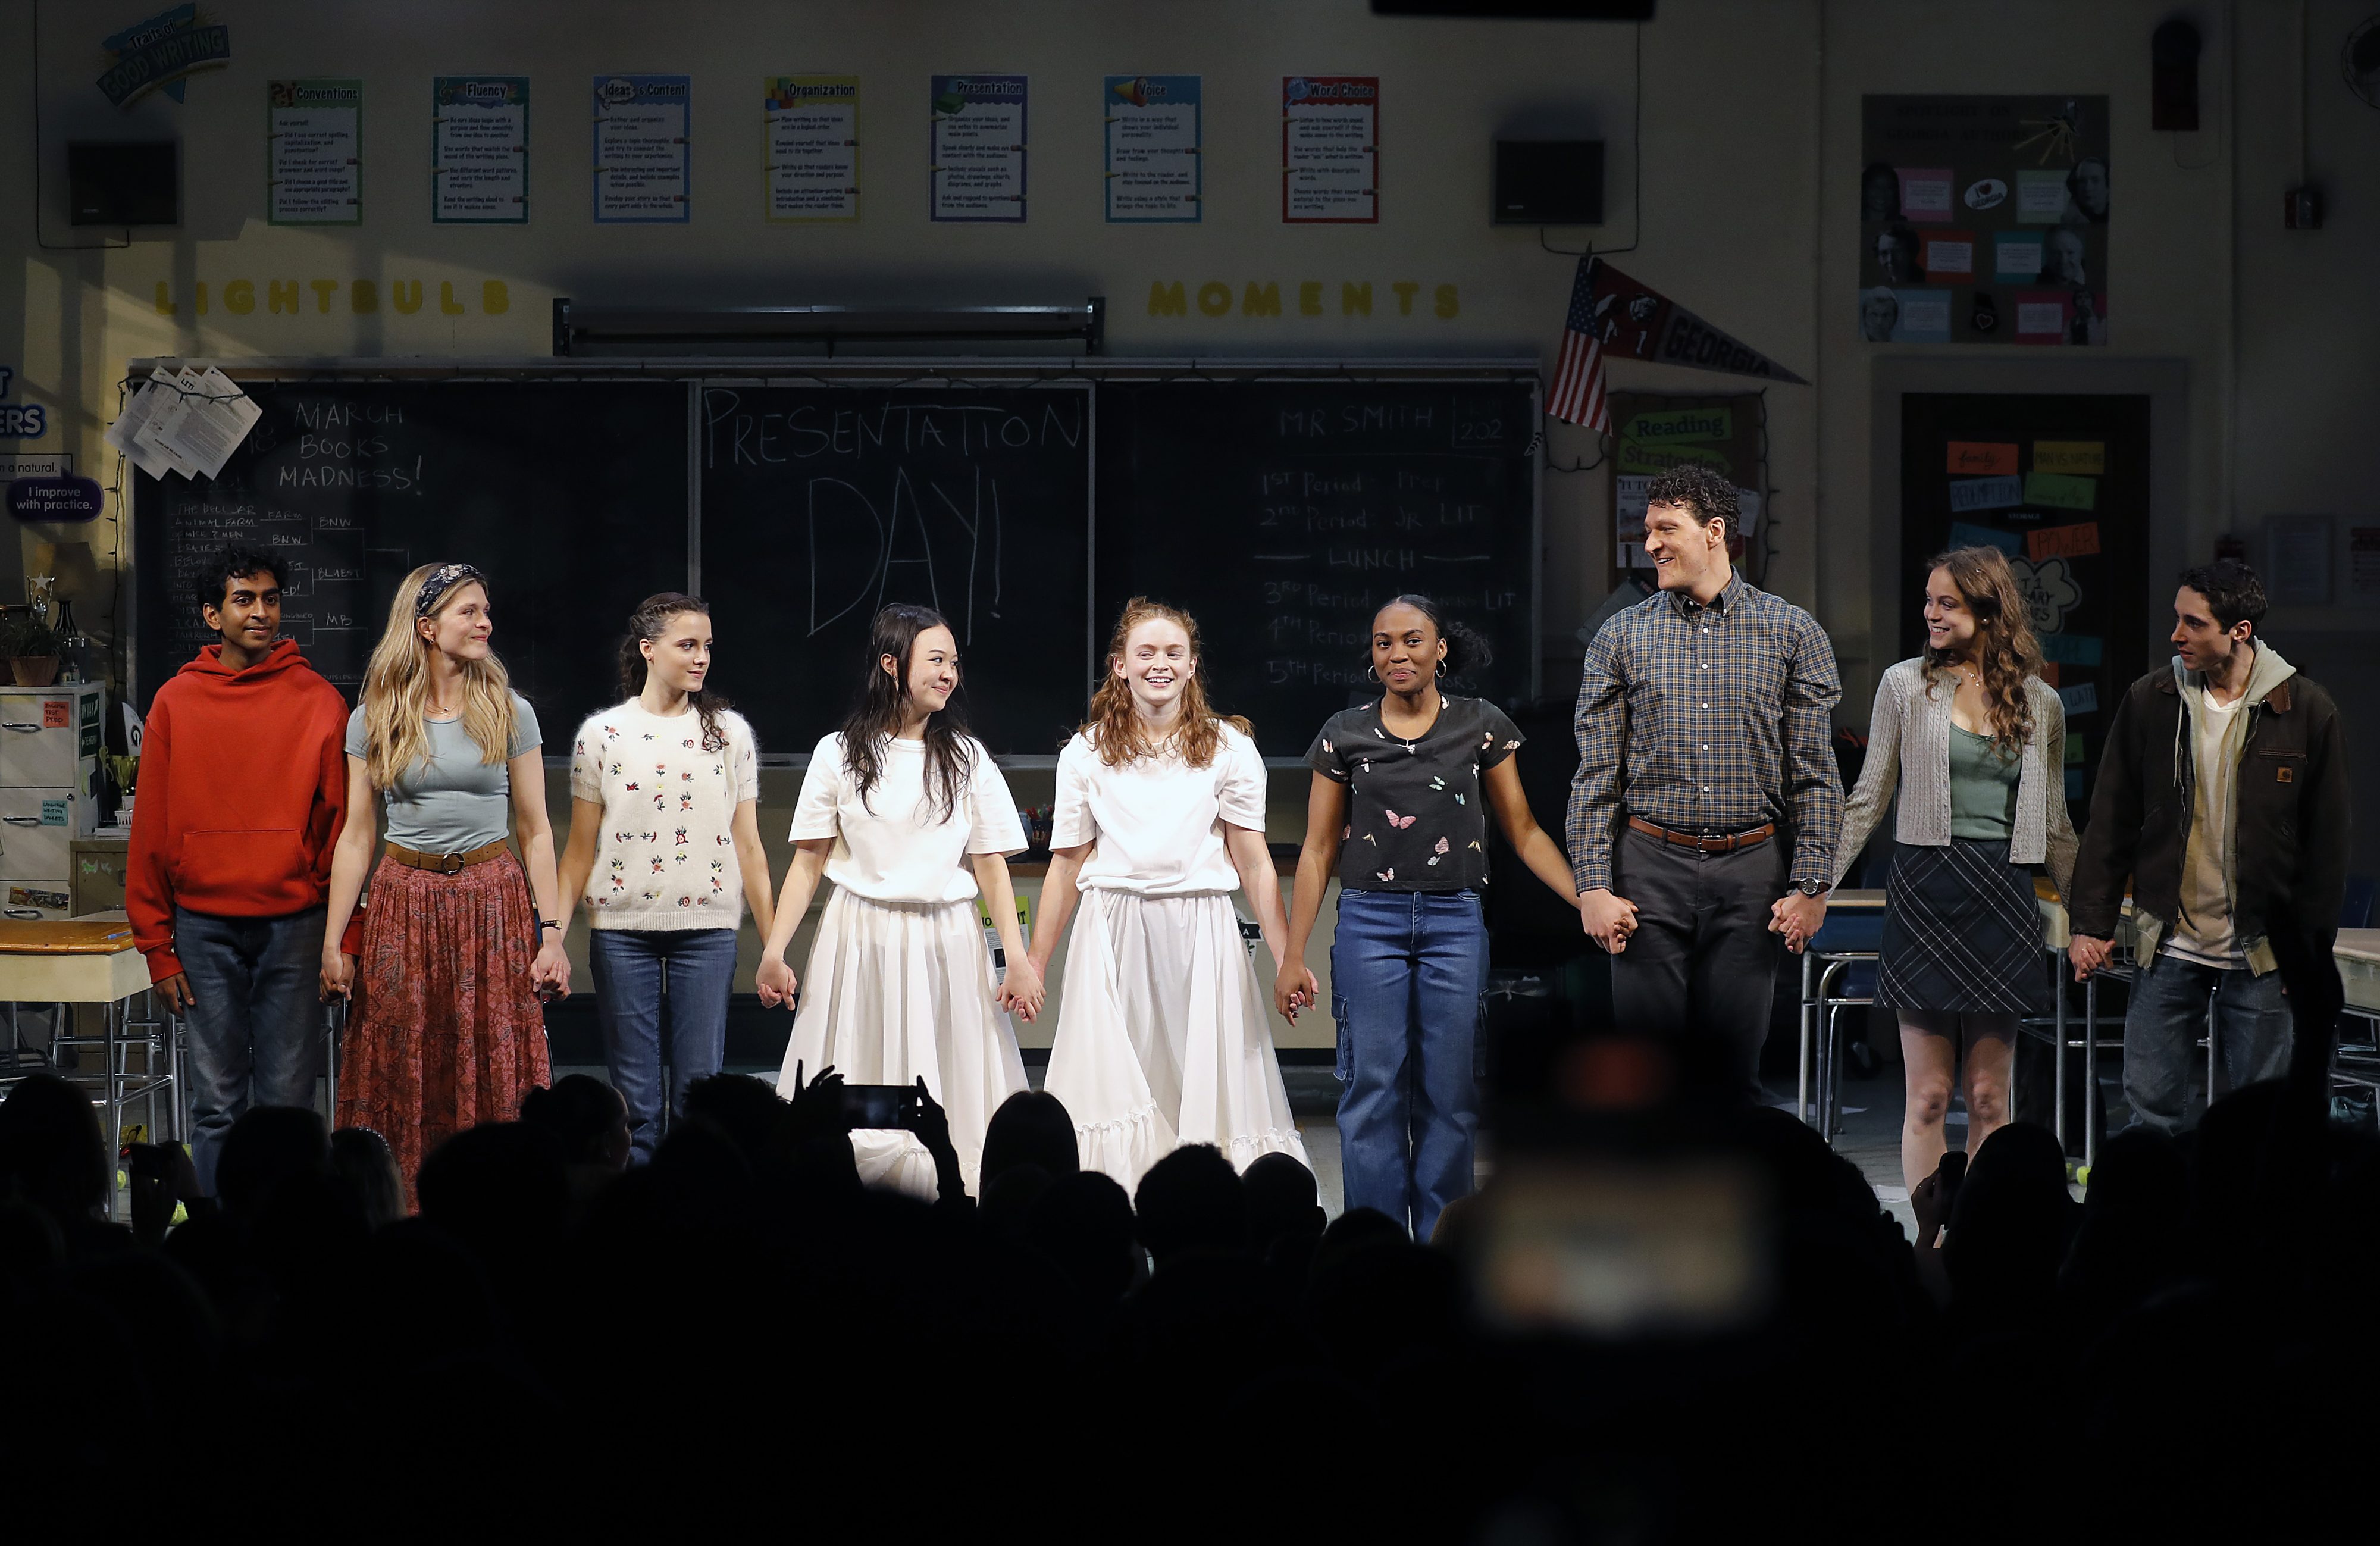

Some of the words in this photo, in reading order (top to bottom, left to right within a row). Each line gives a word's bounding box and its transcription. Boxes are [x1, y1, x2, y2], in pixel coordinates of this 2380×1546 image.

[129, 27, 162, 50] Traits
[162, 18, 177, 36] of
[104, 56, 150, 94] GOOD
[151, 29, 225, 69] WRITING
[298, 87, 358, 101] Conventions
[466, 82, 508, 99] Fluency
[605, 83, 631, 96] Ideas
[647, 83, 685, 96] Content
[789, 83, 856, 97] Organization
[957, 81, 1022, 95] Presentation
[1139, 83, 1167, 96] Voice
[1311, 83, 1338, 97] Word
[1342, 83, 1374, 97] Choice
[1990, 105, 2011, 117] ON
[1887, 128, 1949, 141] GEORGIA
[1959, 127, 2029, 141] AUTHORS
[155, 279, 510, 316] LIGHTBULB
[1147, 280, 1460, 319] MOMENTS
[1665, 315, 1770, 376] GEORGIA
[294, 401, 403, 430] MARCH
[1342, 404, 1433, 433] SMITH
[703, 388, 1082, 470] PRESENTATION
[1461, 418, 1504, 440] 202
[1636, 415, 1725, 437] Reading
[299, 433, 389, 460] BOOKS
[18, 462, 57, 472] natural.
[1958, 449, 2002, 470] family
[278, 454, 424, 497] MADNESS!
[36, 486, 82, 500] improve
[17, 499, 41, 510] with
[44, 499, 93, 512] practice.
[178, 503, 199, 515] THE
[1440, 502, 1482, 526] LIT
[319, 516, 352, 528] BNW
[2007, 513, 2041, 521] STORAGE
[221, 530, 244, 539] MEN
[271, 534, 303, 544] BNW
[2037, 524, 2097, 558] POWER
[806, 461, 1002, 647] DAY!
[1328, 547, 1415, 572] LUNCH
[317, 568, 361, 578] BLUEST
[1485, 589, 1517, 611] LIT
[326, 612, 353, 626] MB
